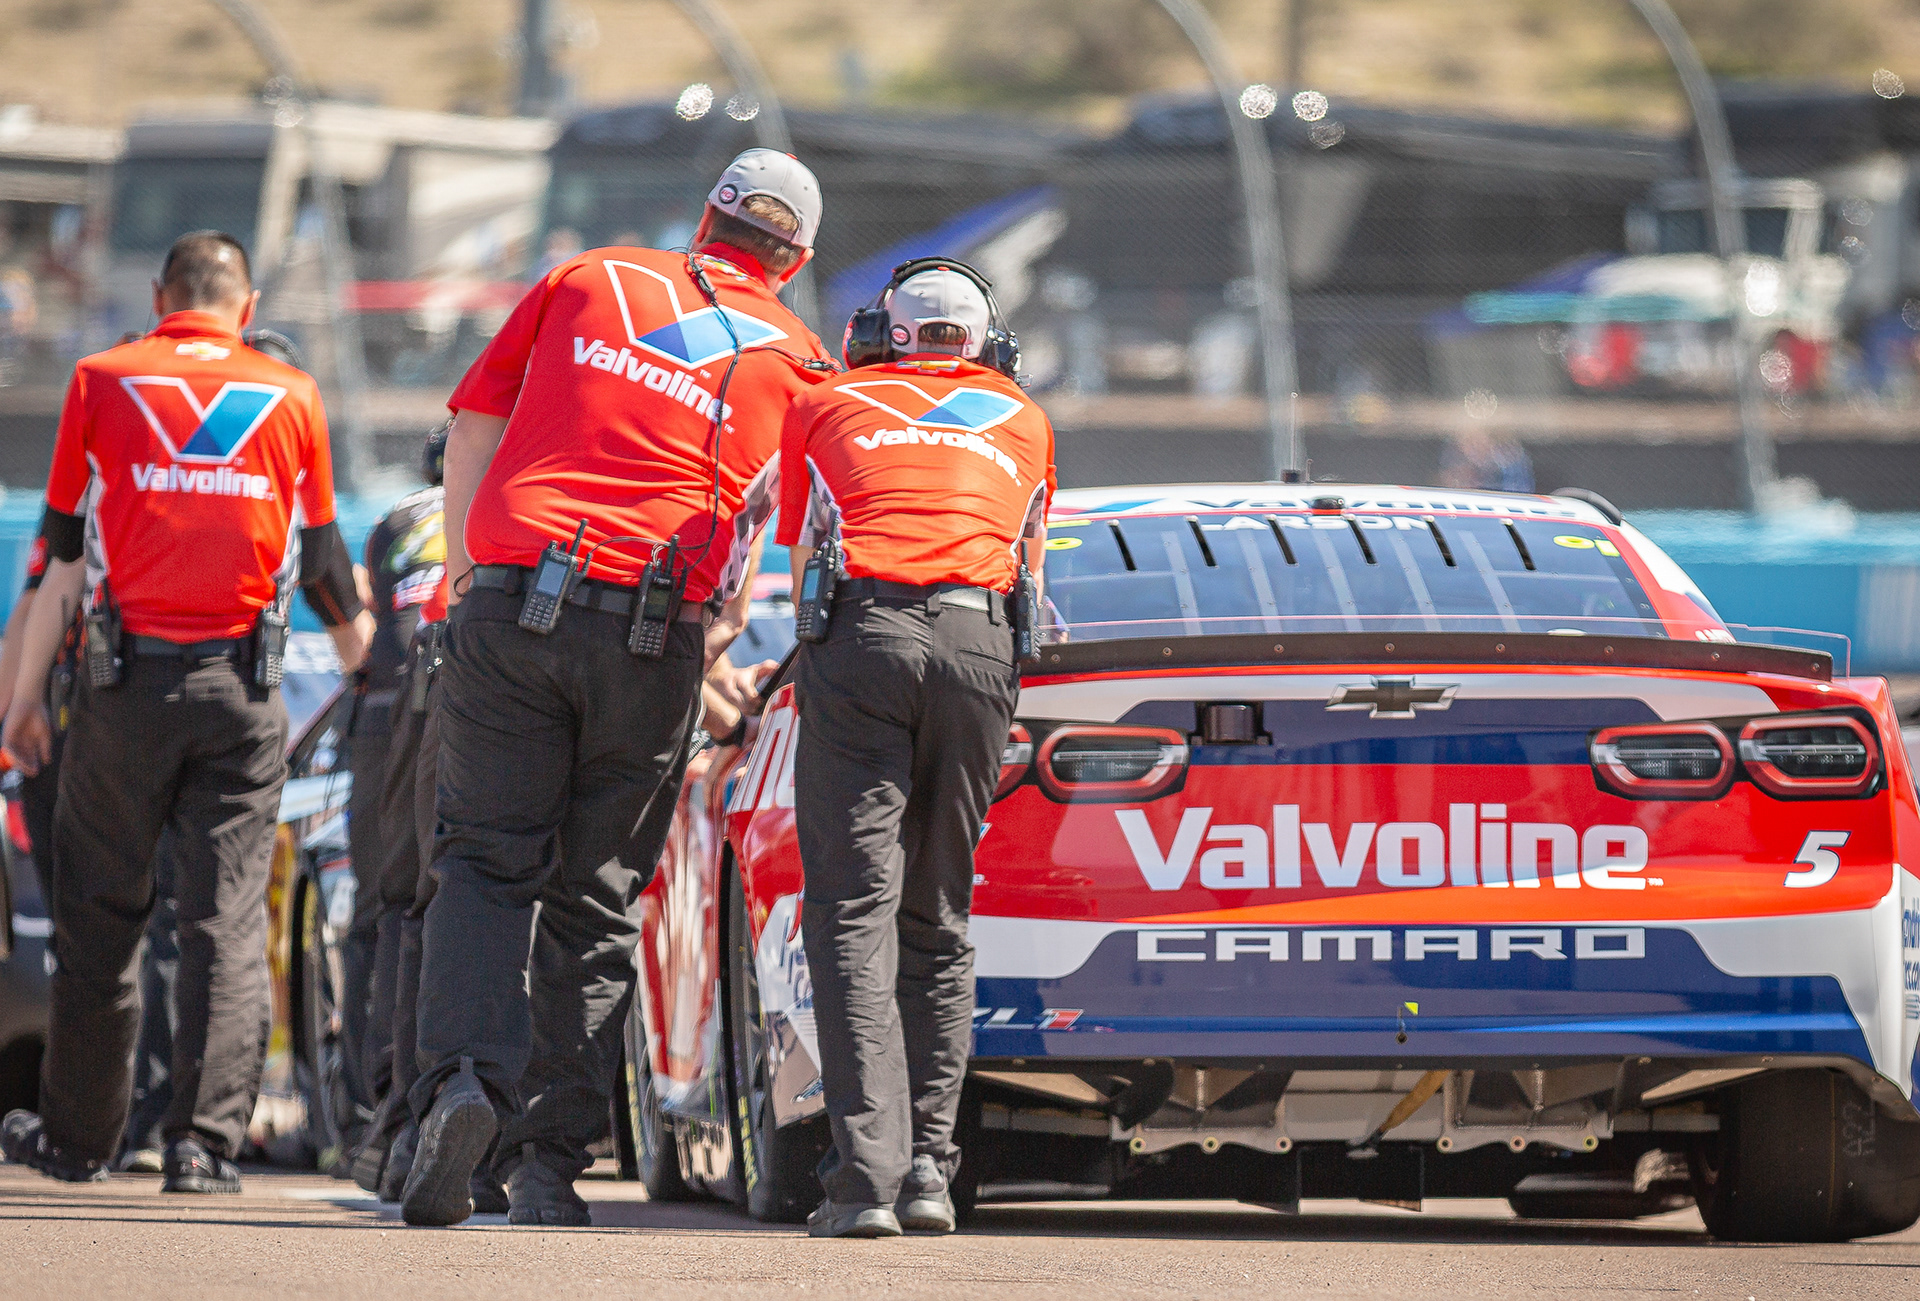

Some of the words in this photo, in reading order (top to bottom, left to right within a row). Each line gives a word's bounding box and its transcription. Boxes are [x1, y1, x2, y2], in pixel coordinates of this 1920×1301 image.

[573, 336, 733, 424] Valvoline
[131, 463, 270, 500] Valvoline
[1114, 803, 1649, 891] Valvoline
[1783, 830, 1851, 888] 5
[1137, 927, 1646, 961] CAMARO
